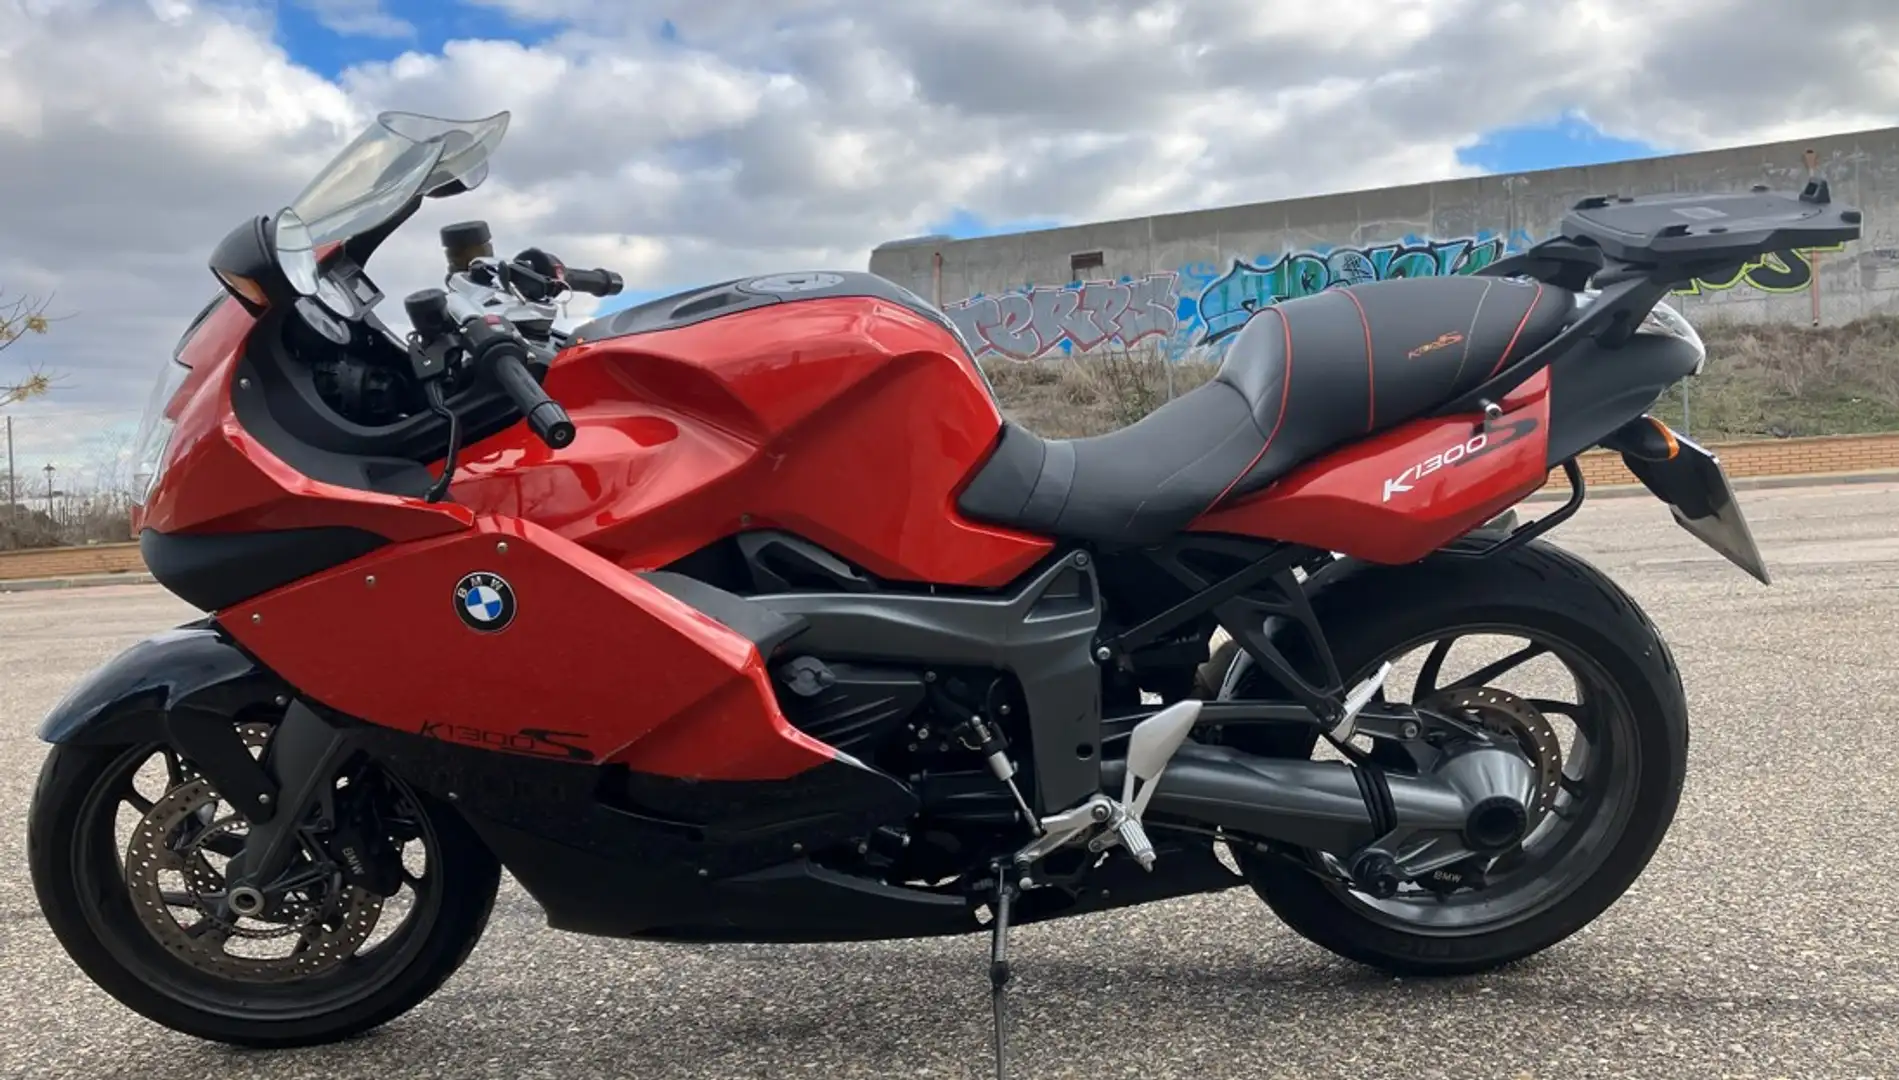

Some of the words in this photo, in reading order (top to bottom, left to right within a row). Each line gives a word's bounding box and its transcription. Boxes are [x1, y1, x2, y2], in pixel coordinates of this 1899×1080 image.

[1382, 404, 1538, 502] K1300S
[457, 575, 504, 600] BMW
[419, 720, 595, 762] K1300S
[341, 847, 366, 875] BMW
[1433, 870, 1463, 883] BMW
